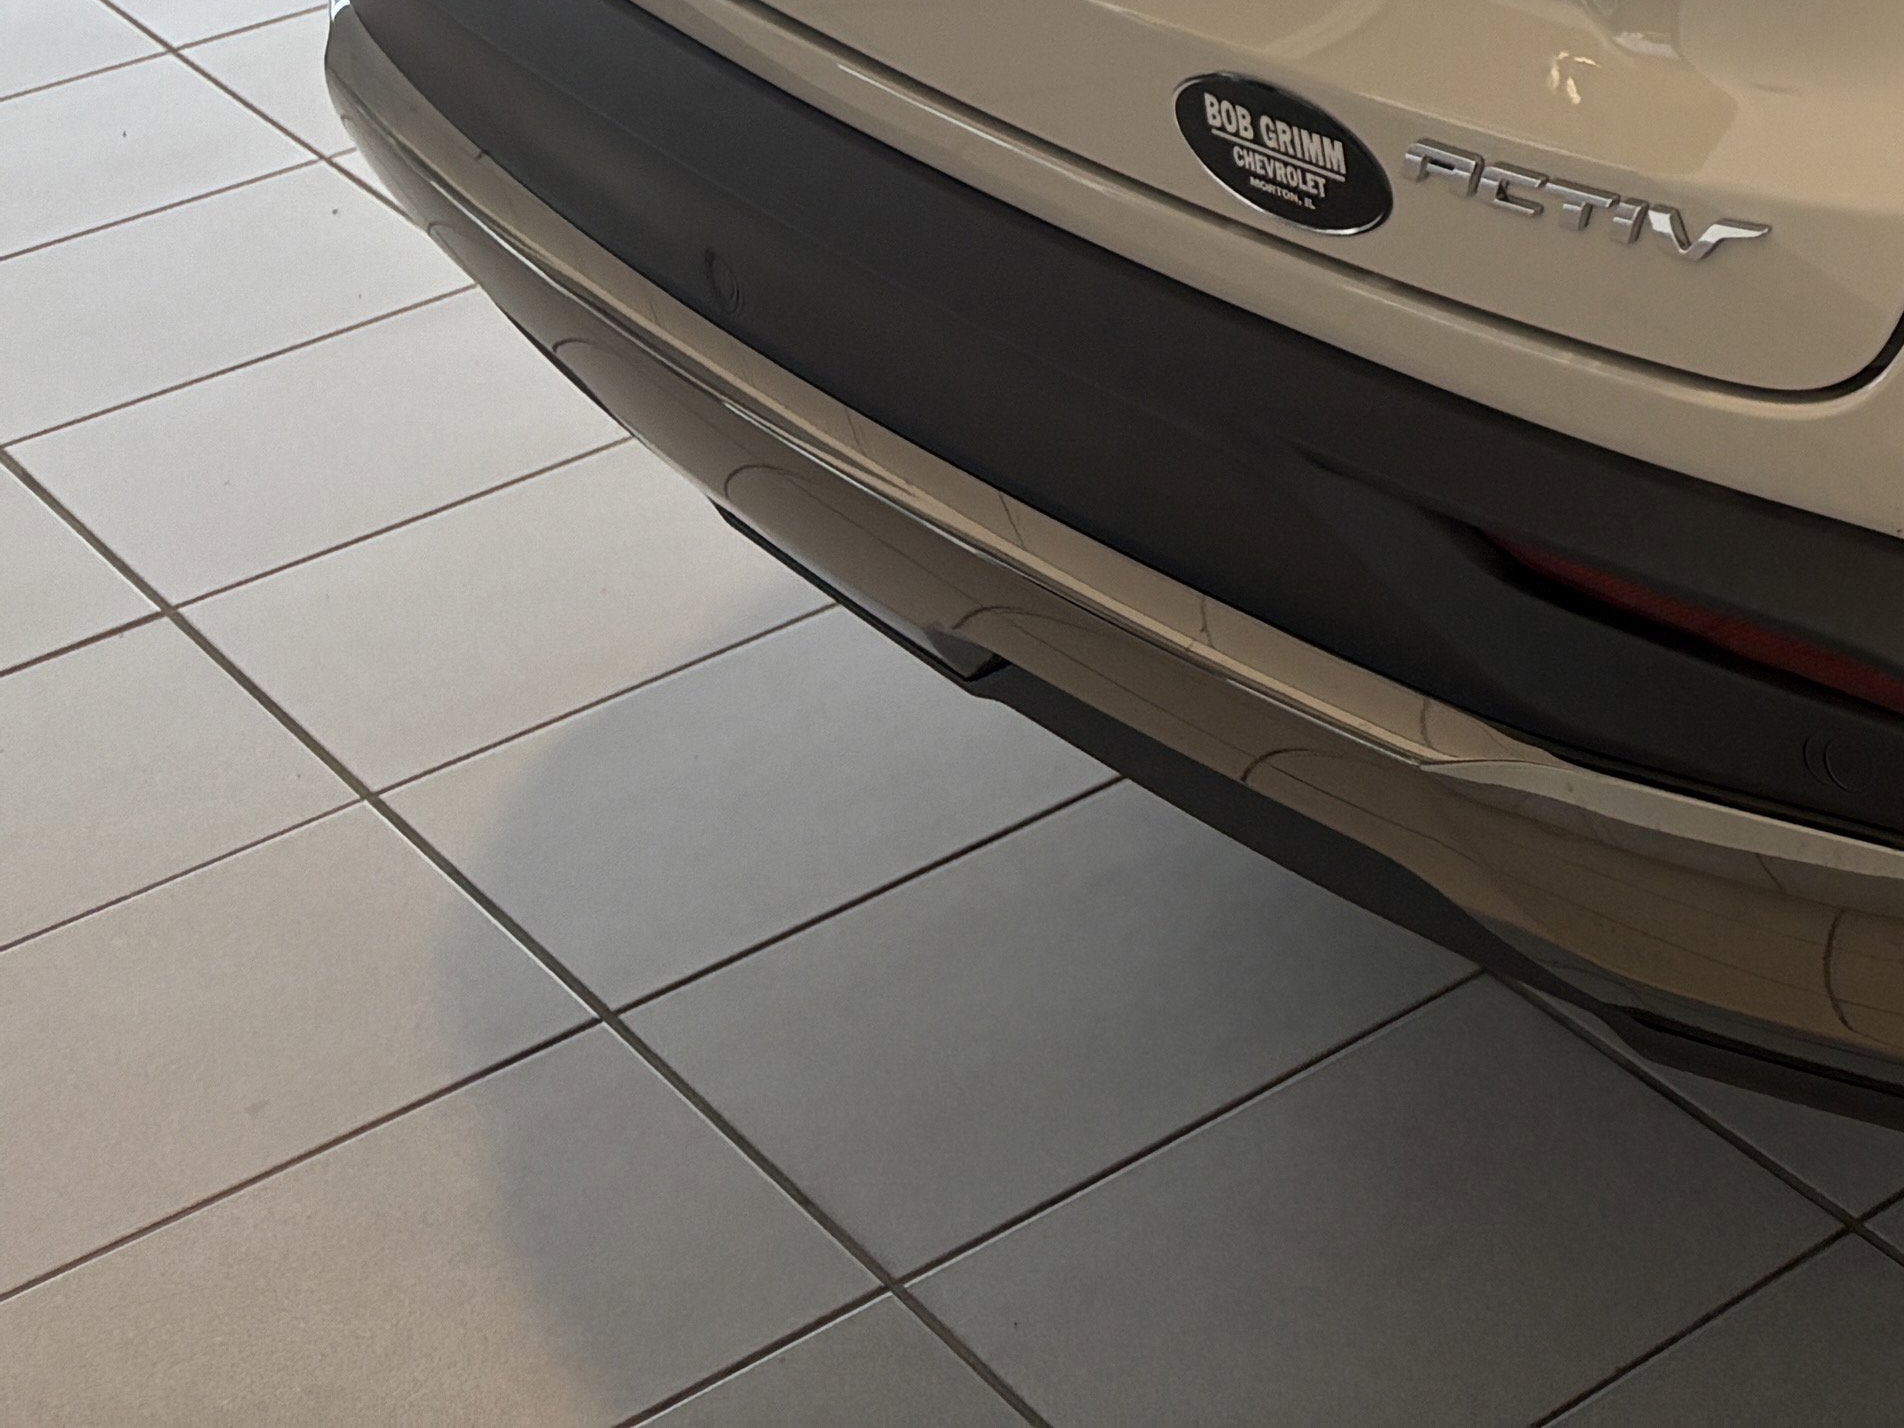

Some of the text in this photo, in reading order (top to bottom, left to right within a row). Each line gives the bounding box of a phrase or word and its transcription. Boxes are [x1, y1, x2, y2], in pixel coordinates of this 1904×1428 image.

[1203, 91, 1347, 175] BOB GRIMM
[1232, 145, 1326, 198] CHEVROLET
[1303, 197, 1317, 210] IL
[1404, 136, 1772, 262] ACTIV
